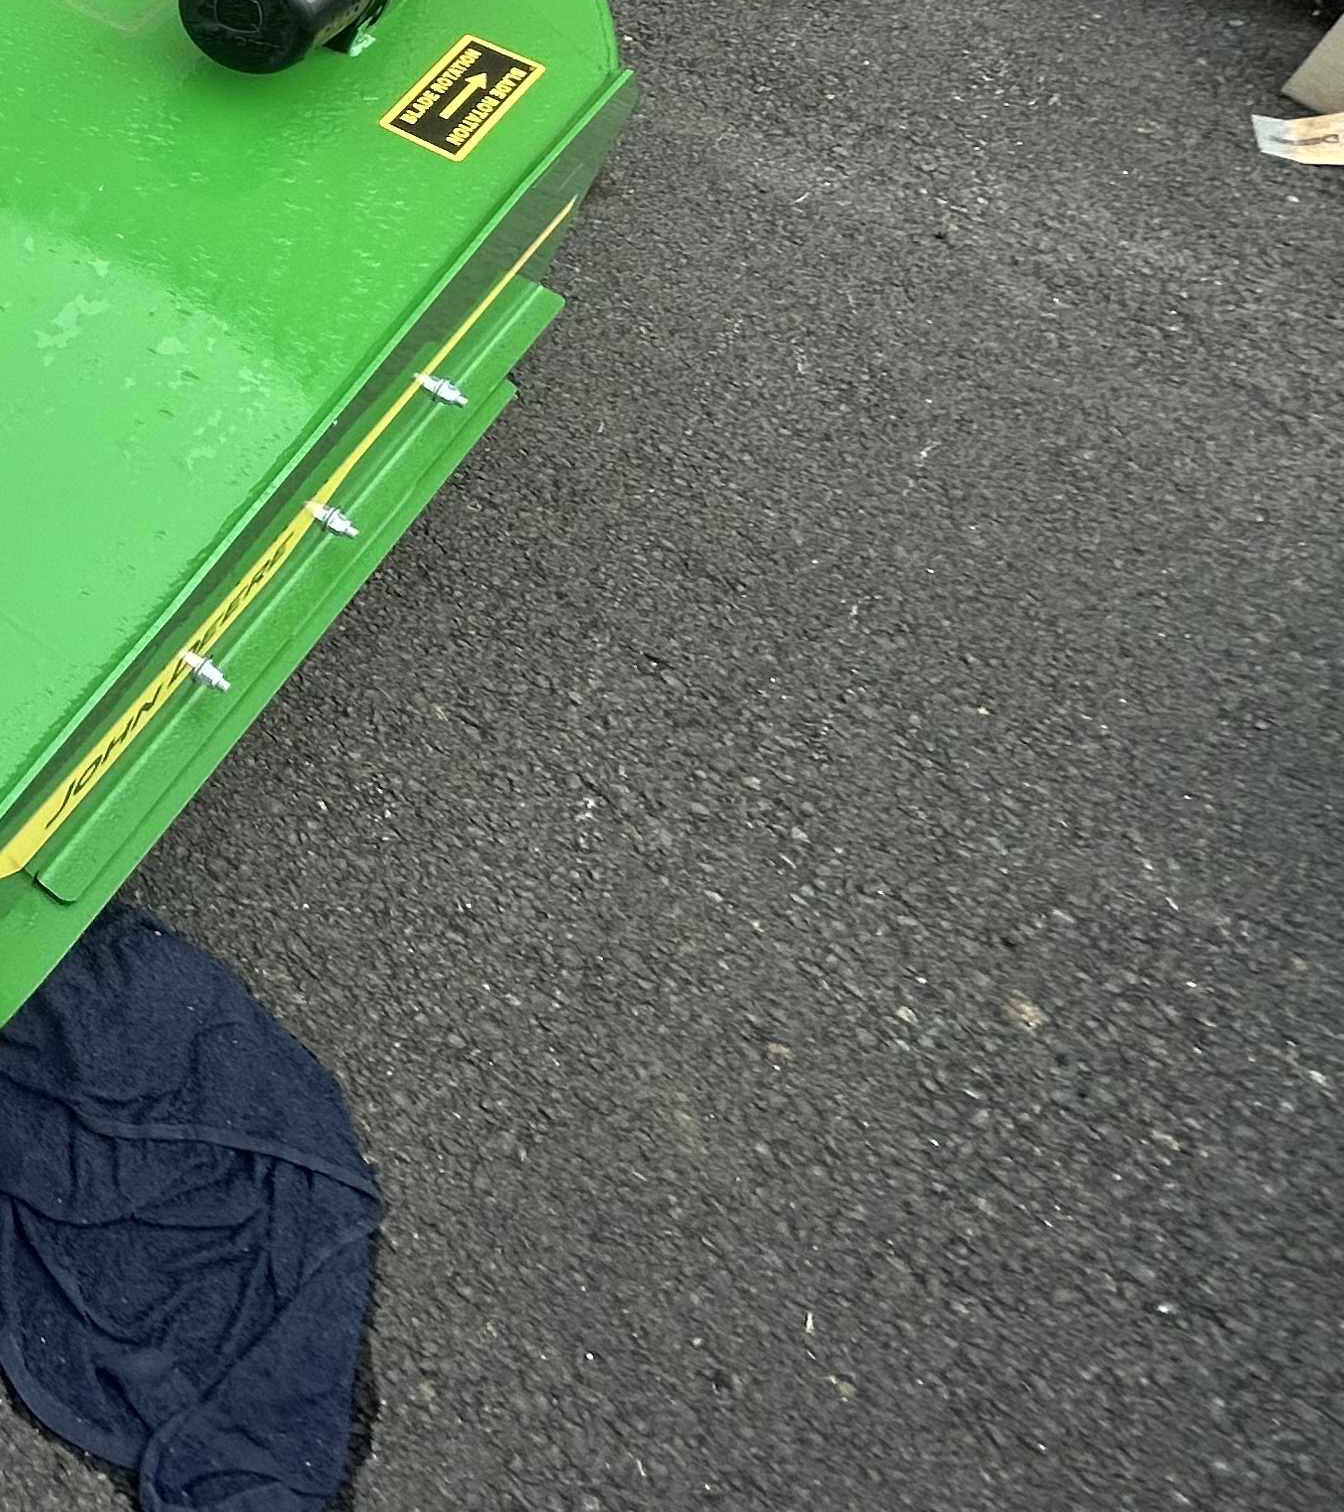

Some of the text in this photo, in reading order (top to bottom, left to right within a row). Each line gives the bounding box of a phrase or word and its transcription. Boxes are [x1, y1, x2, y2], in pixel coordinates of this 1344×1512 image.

[398, 48, 482, 125] BLADE ROTATION
[446, 67, 528, 147] BLADE ROTATION
[45, 531, 295, 830] JOHN DEERE
